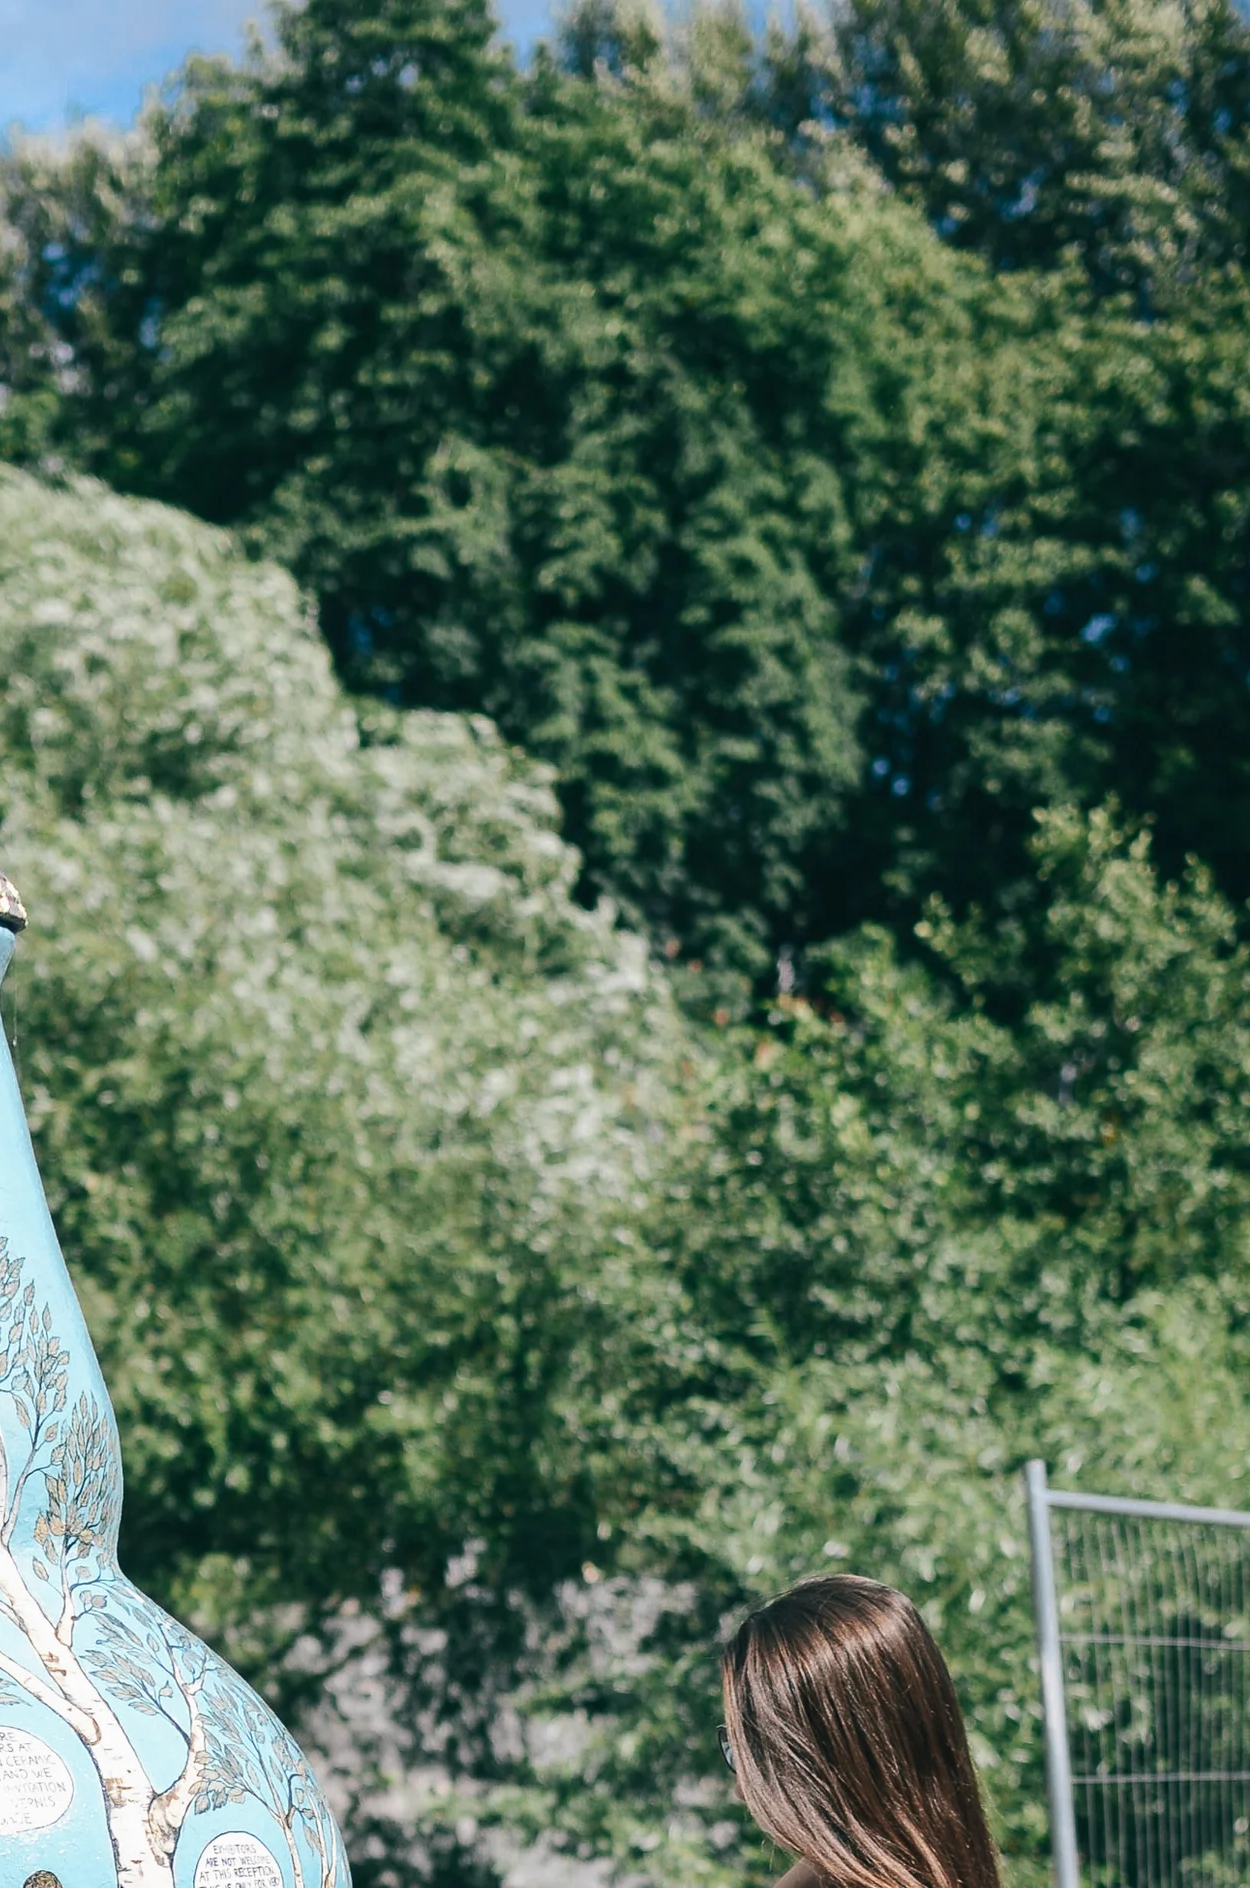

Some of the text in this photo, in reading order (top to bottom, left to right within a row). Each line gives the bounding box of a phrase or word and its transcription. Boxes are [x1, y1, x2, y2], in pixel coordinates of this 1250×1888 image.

[18, 1743, 31, 1752] AT
[206, 1857, 218, 1868] ARE
[222, 1857, 236, 1866] NOT
[199, 1866, 275, 1882] AT THIS RECEPTION
